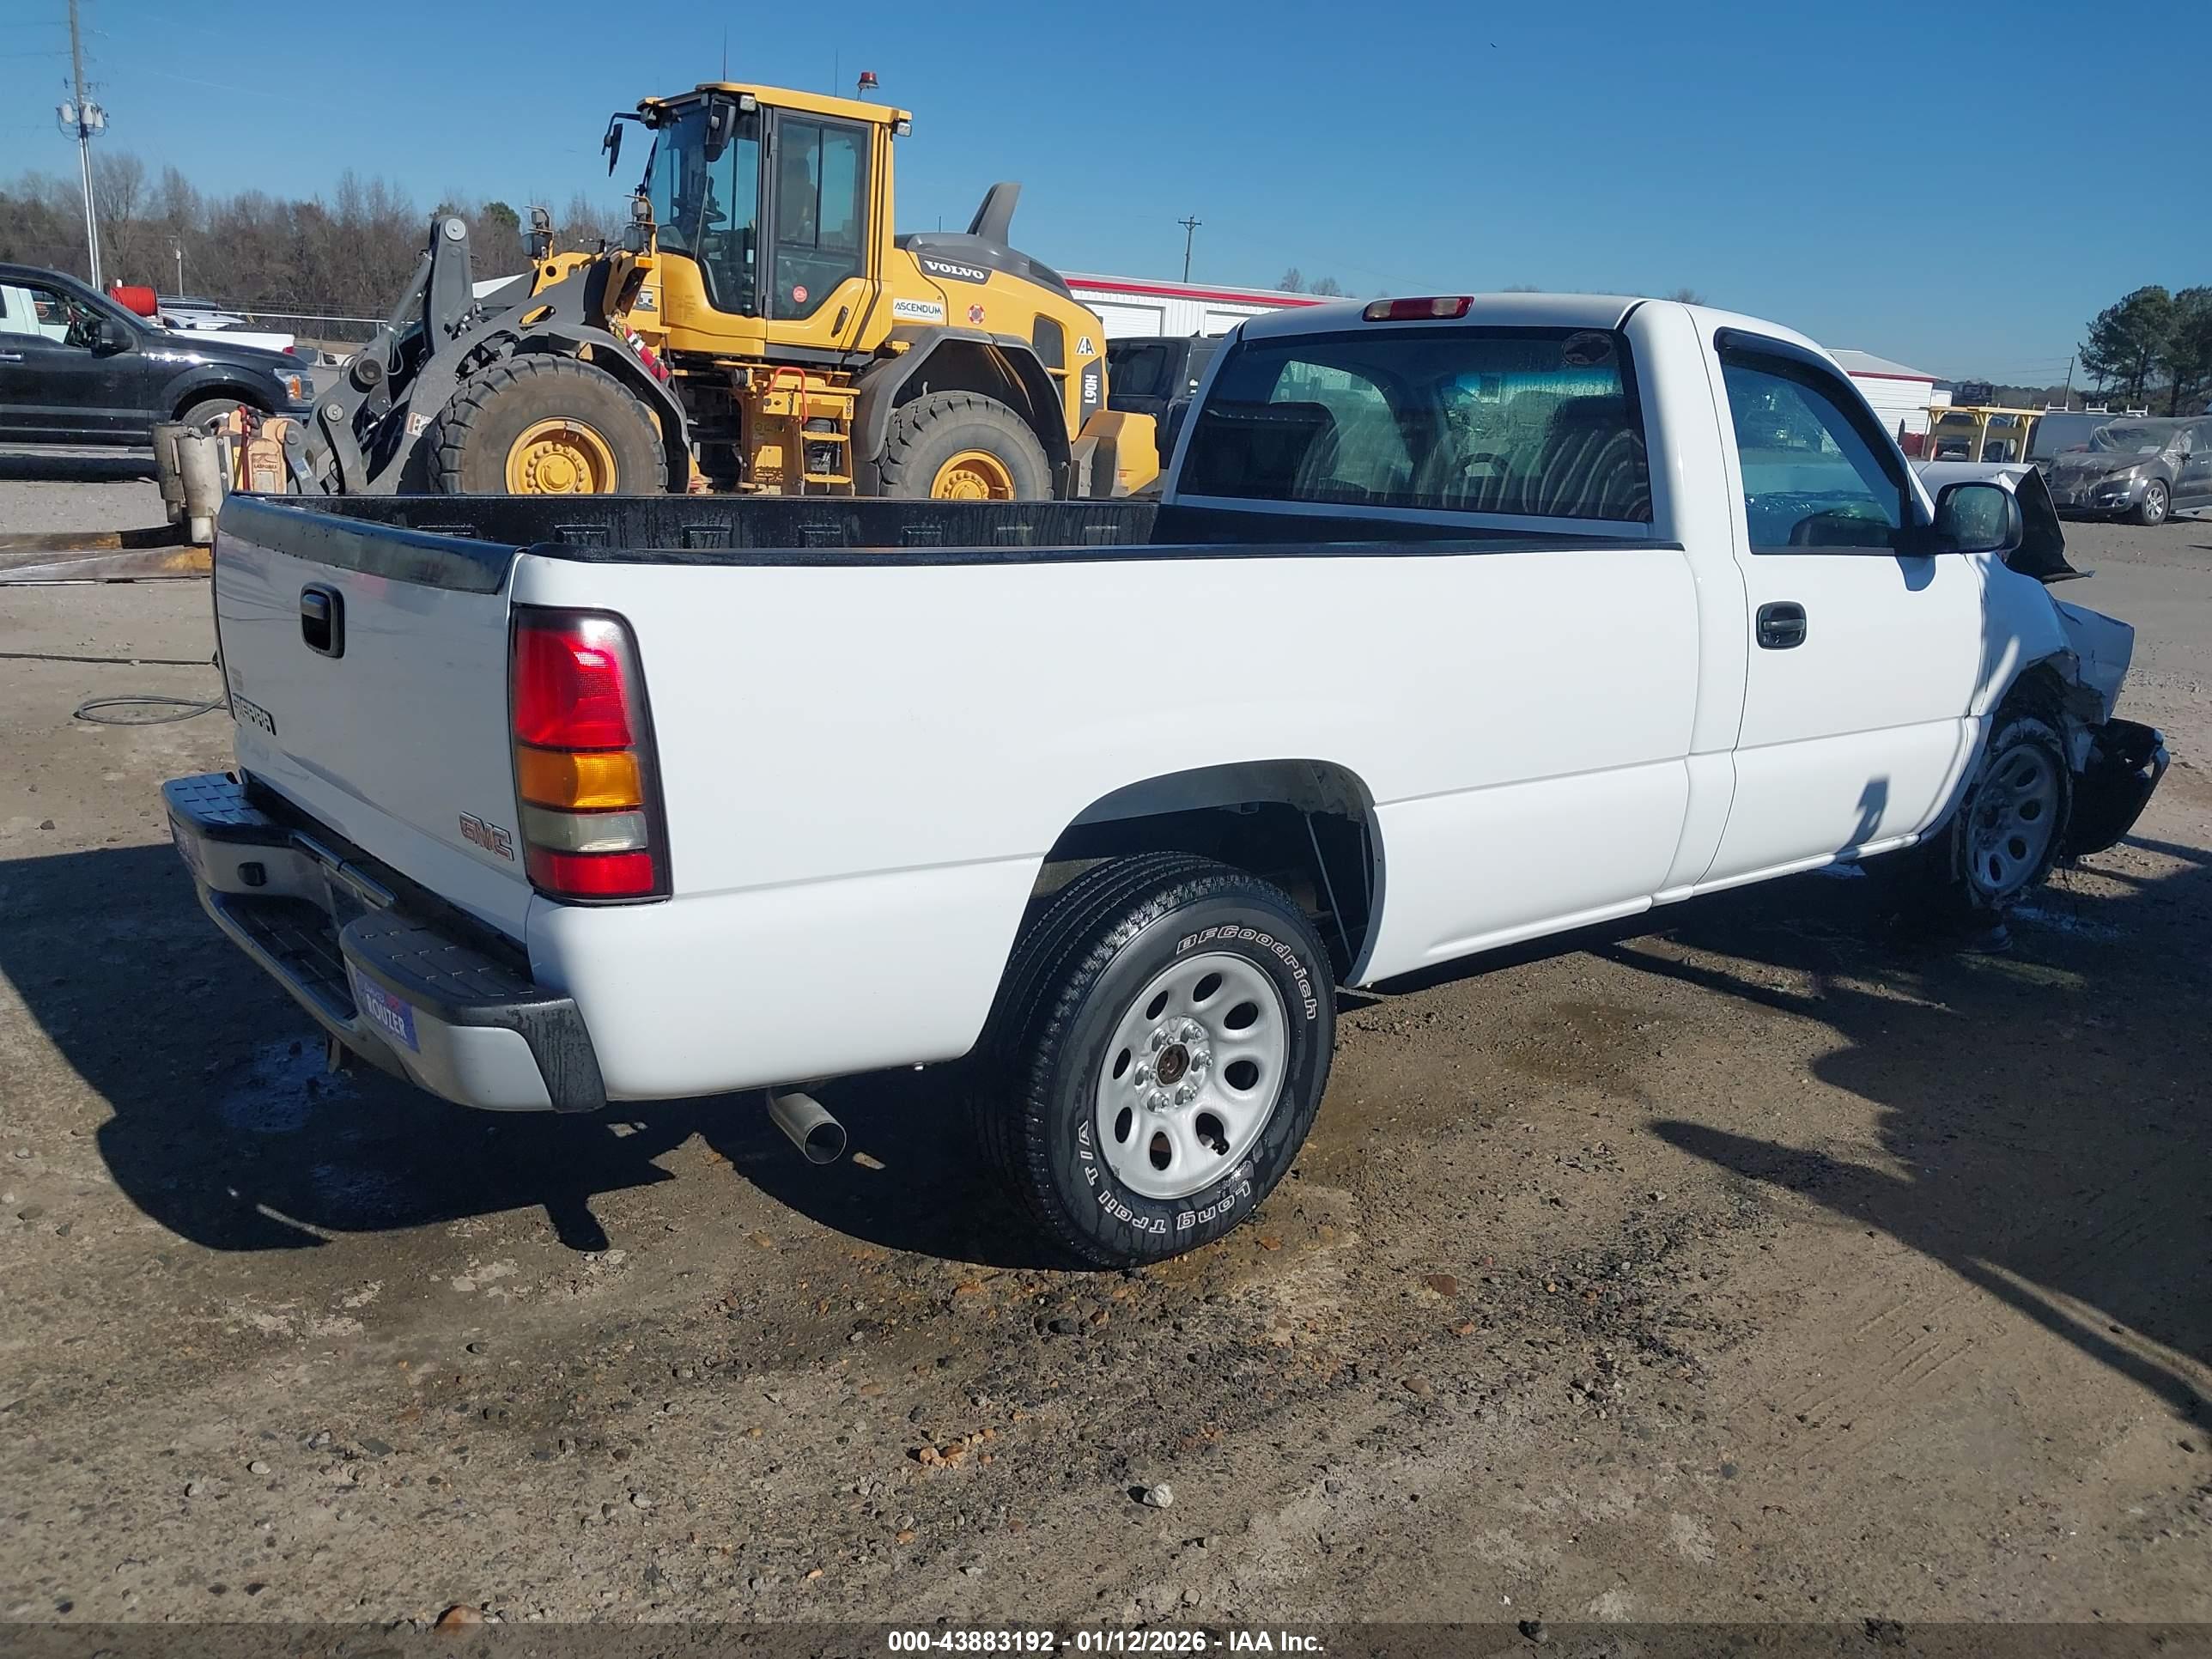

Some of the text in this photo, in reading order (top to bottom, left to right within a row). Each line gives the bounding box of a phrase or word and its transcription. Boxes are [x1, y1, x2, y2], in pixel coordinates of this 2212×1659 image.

[924, 259, 985, 280] VOLVO
[894, 301, 943, 315] ASCENDUM
[1084, 374, 1098, 404] L90H
[459, 811, 515, 862] GMC
[1176, 925, 1318, 1020] BFGoodrich
[1098, 1189, 1167, 1234] Trail
[1176, 1179, 1251, 1231] Long
